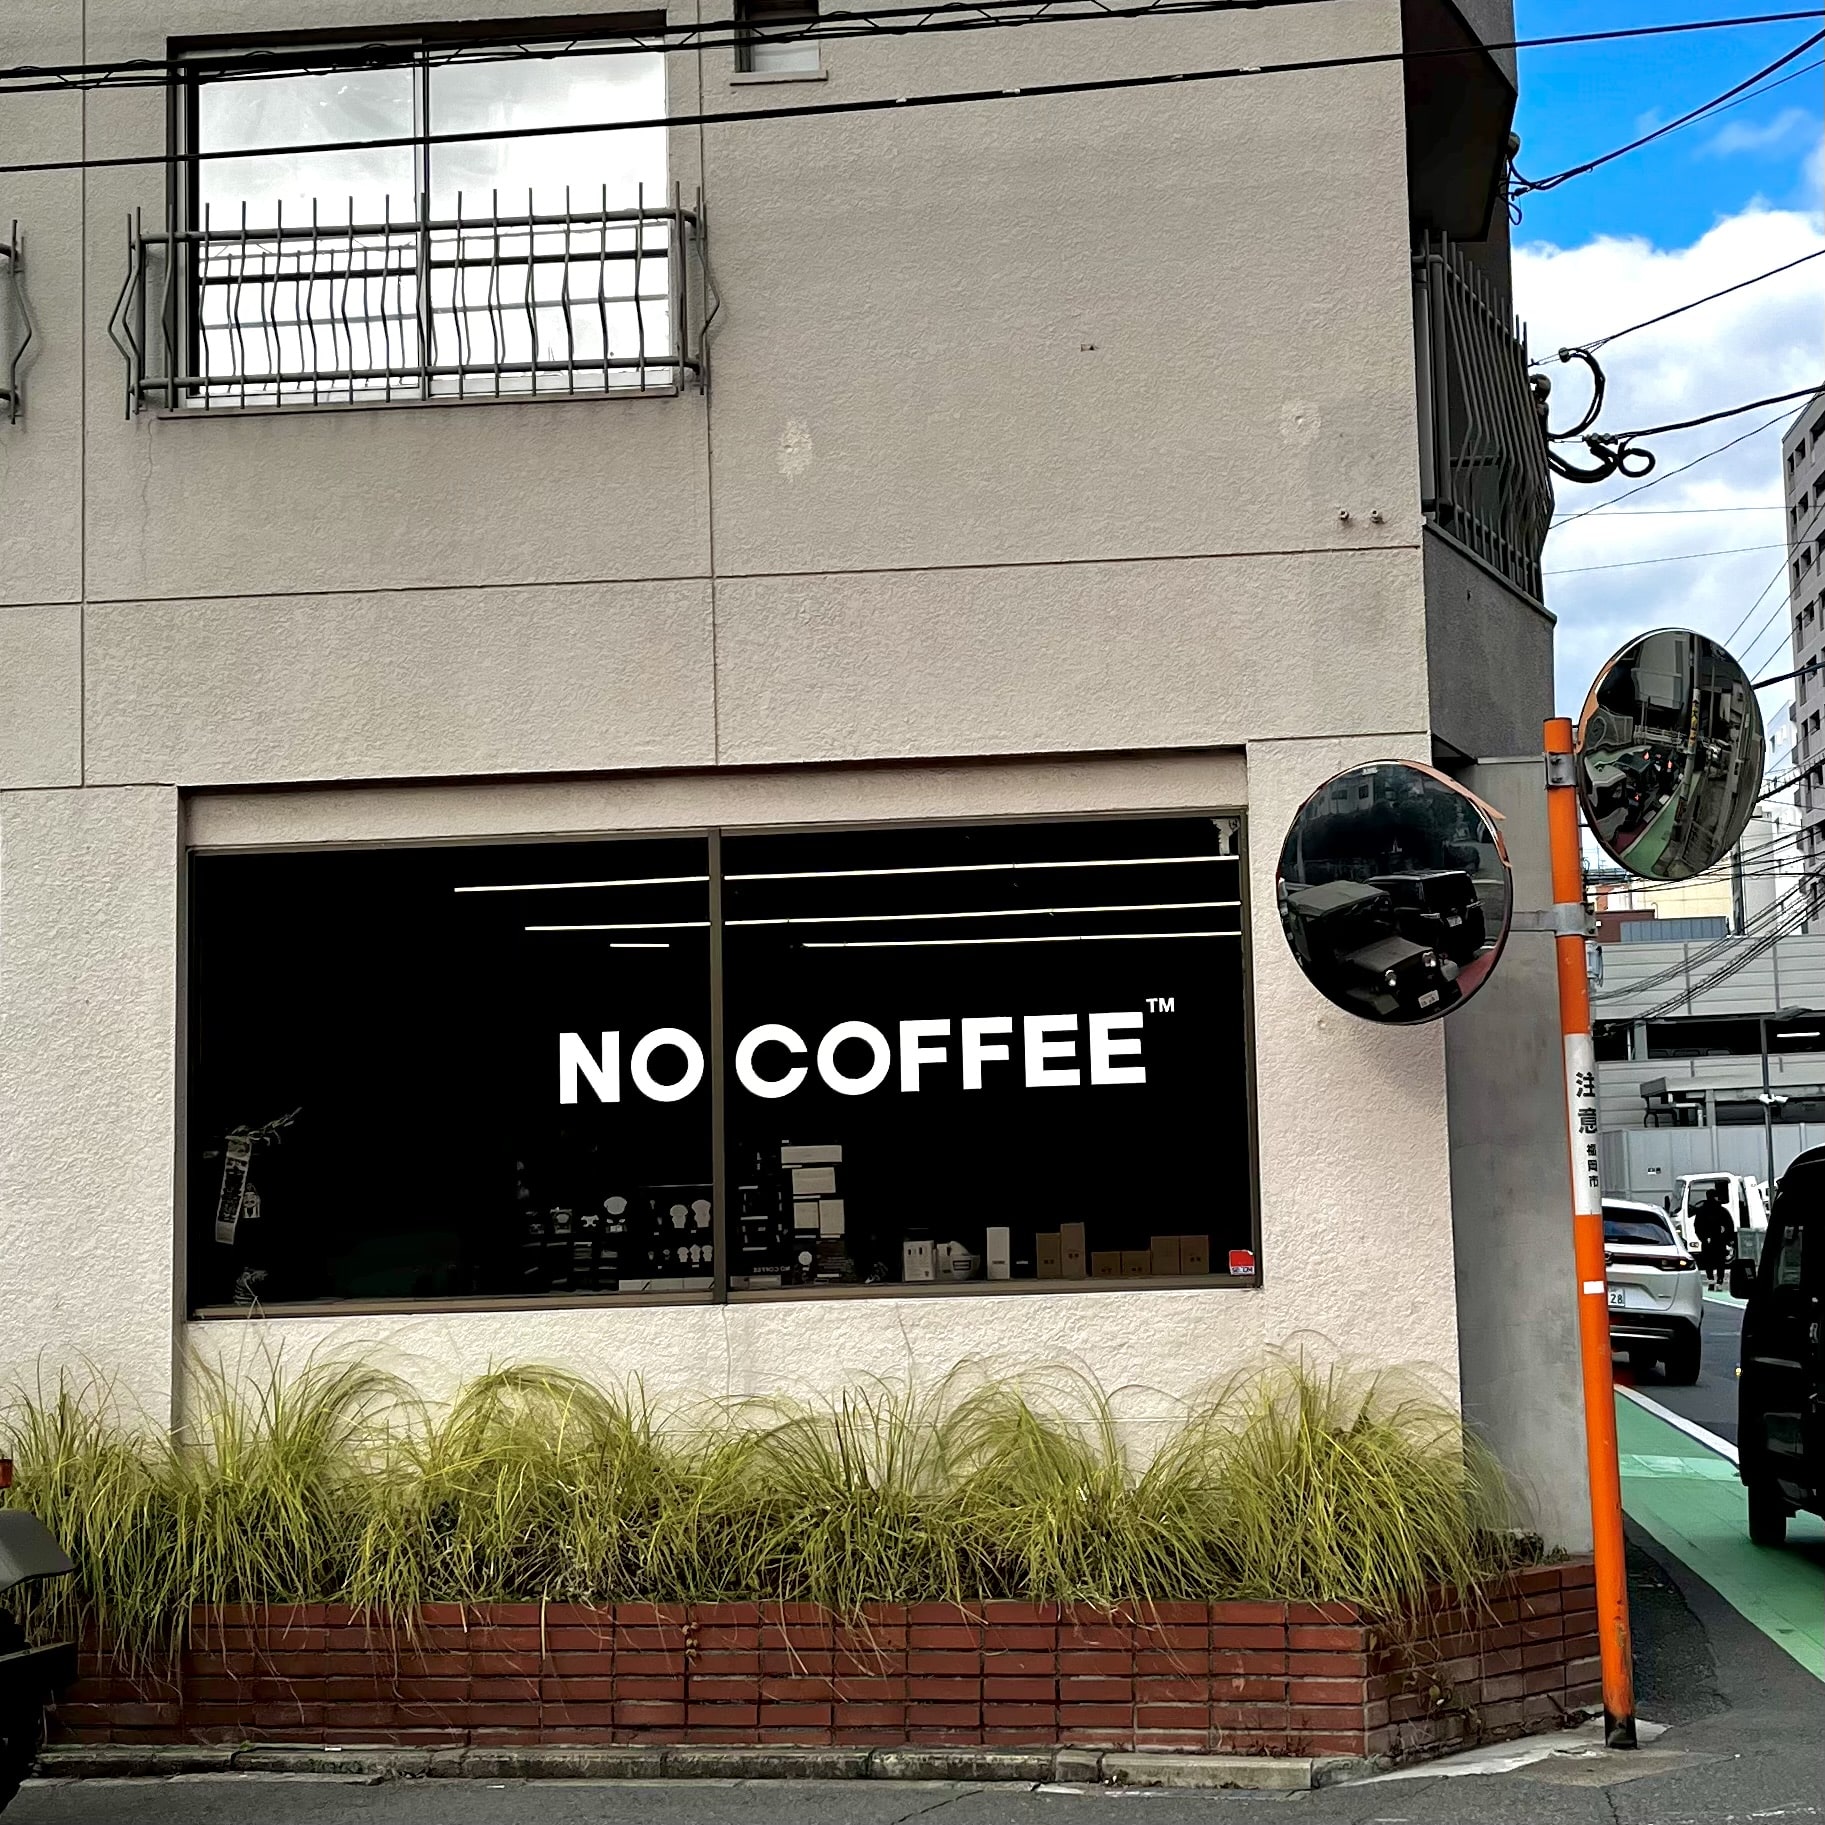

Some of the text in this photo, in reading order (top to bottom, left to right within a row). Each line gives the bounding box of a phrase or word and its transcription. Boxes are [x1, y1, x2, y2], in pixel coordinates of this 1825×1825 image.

[560, 1028, 704, 1104] NO
[736, 1012, 1146, 1098] COFFEE
[1576, 1071, 1598, 1134] 注意
